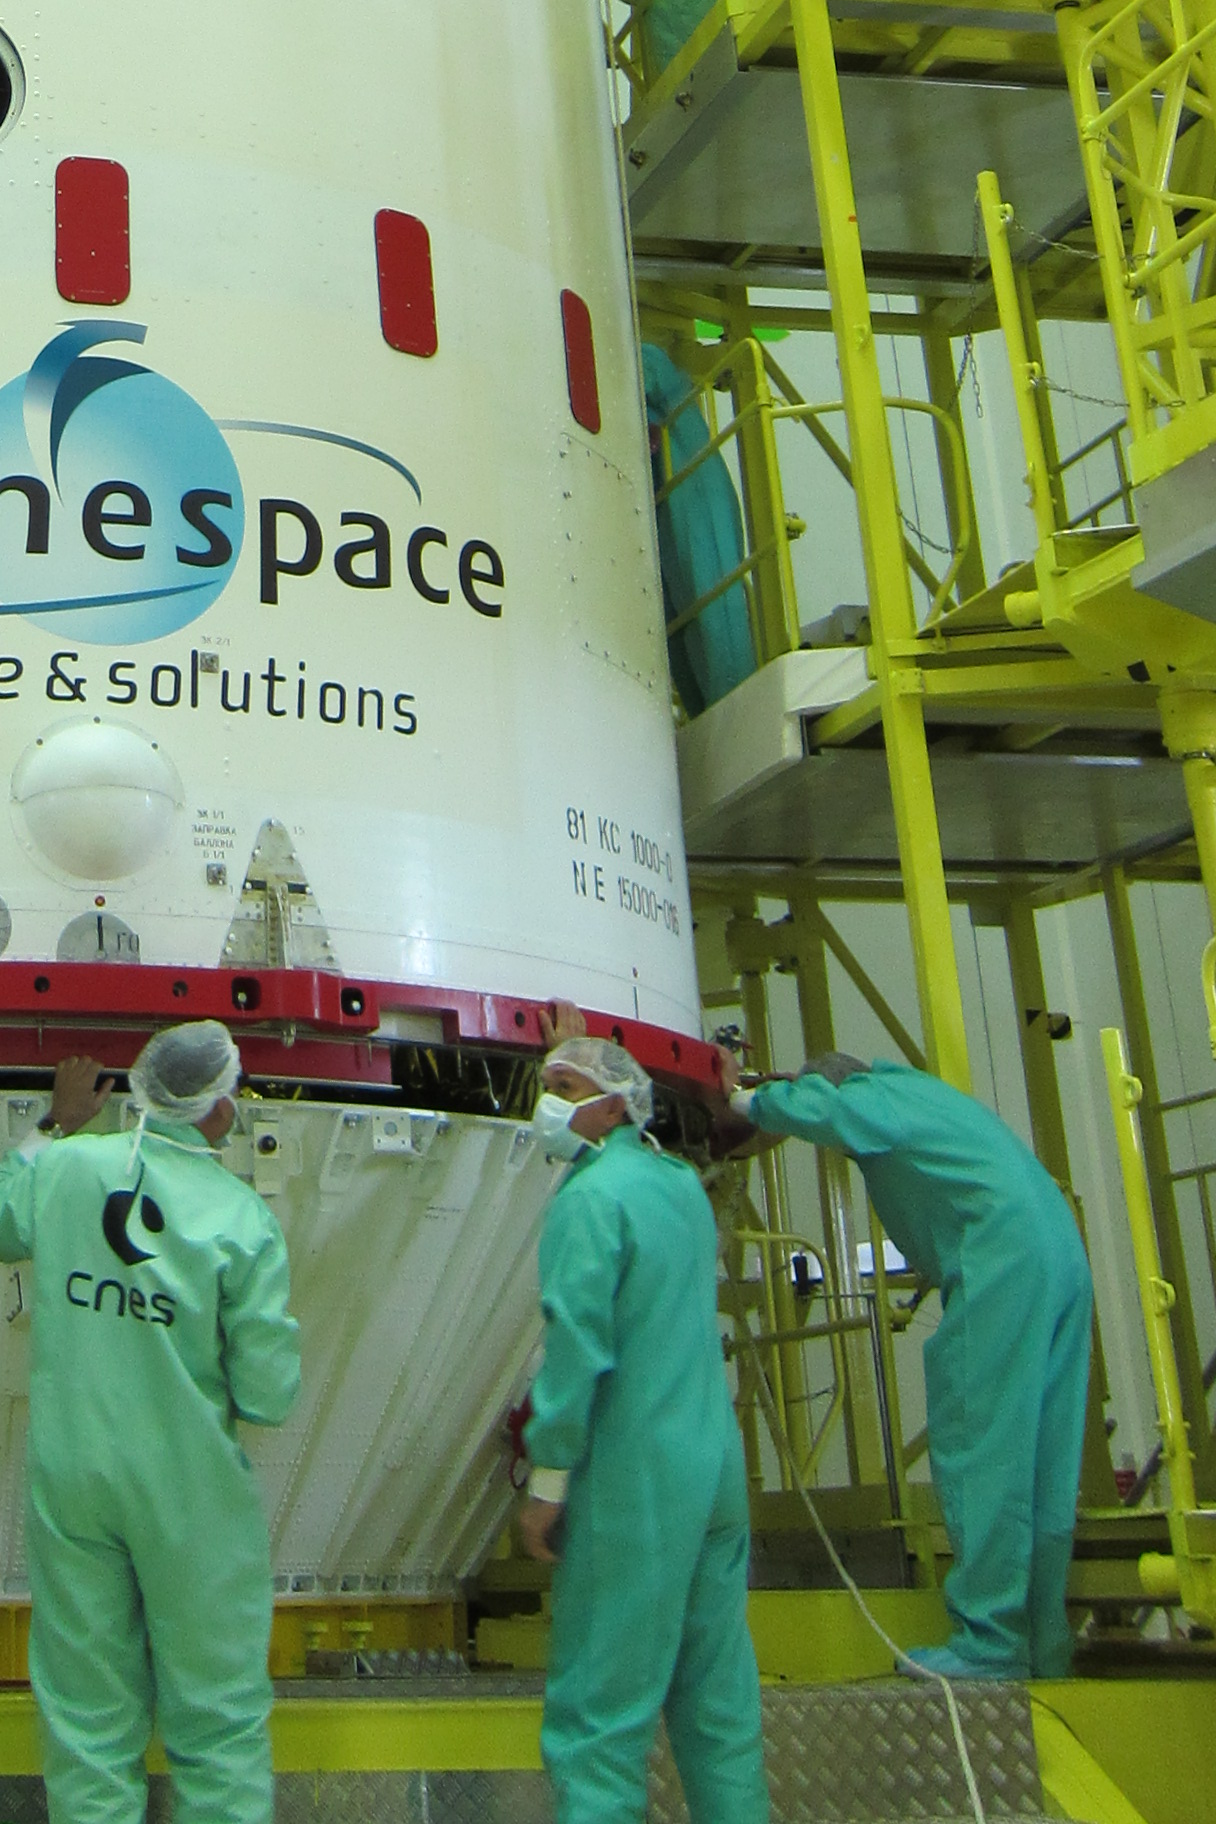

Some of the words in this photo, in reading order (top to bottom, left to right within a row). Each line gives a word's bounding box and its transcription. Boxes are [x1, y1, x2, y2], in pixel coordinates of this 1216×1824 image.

[45, 651, 88, 703] &
[106, 649, 420, 736] solutions
[566, 807, 587, 845] 81
[65, 1270, 178, 1327] cnes
